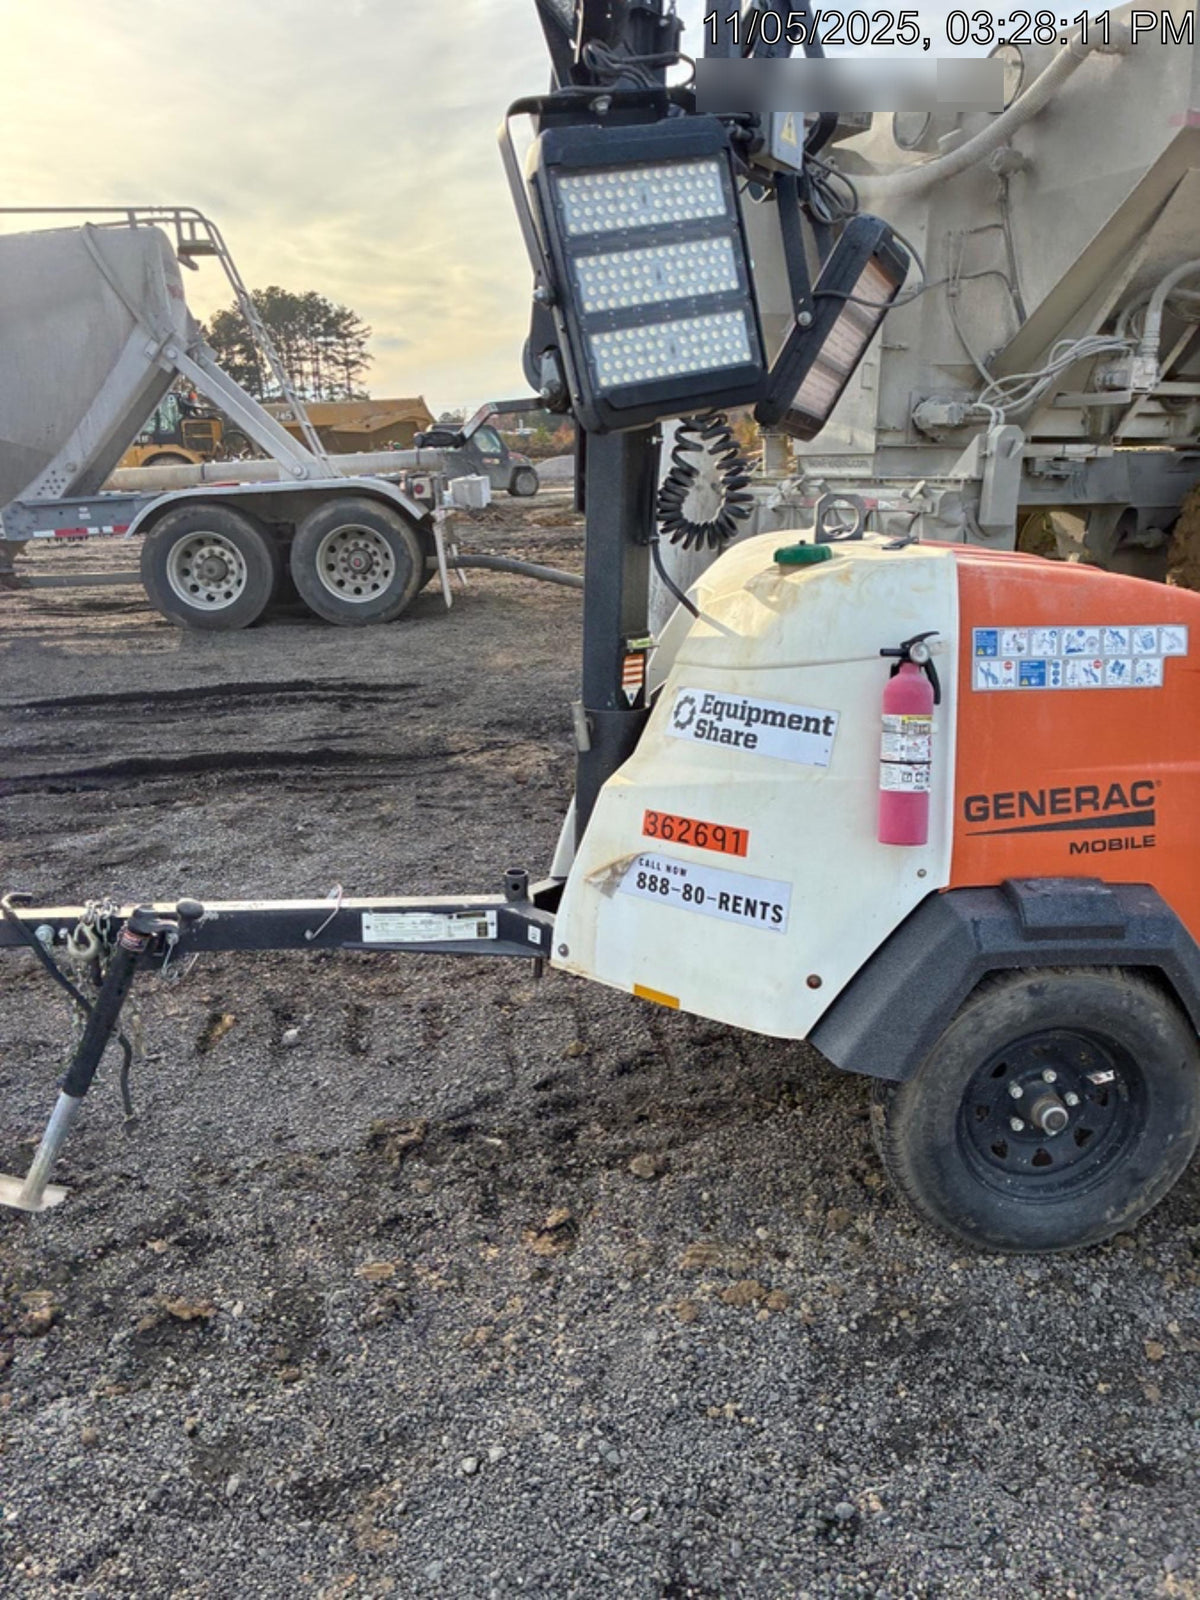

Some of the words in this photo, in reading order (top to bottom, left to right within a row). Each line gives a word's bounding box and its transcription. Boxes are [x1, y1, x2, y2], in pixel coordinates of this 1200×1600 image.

[693, 718, 759, 750] Share
[700, 693, 835, 737] Equipment
[963, 779, 1156, 823] GENERAC
[643, 811, 741, 855] 362691
[1068, 834, 1156, 855] MOBILE
[638, 857, 662, 872] CALL
[666, 862, 688, 878] NOW
[635, 871, 784, 925] 888-80-RENTS
